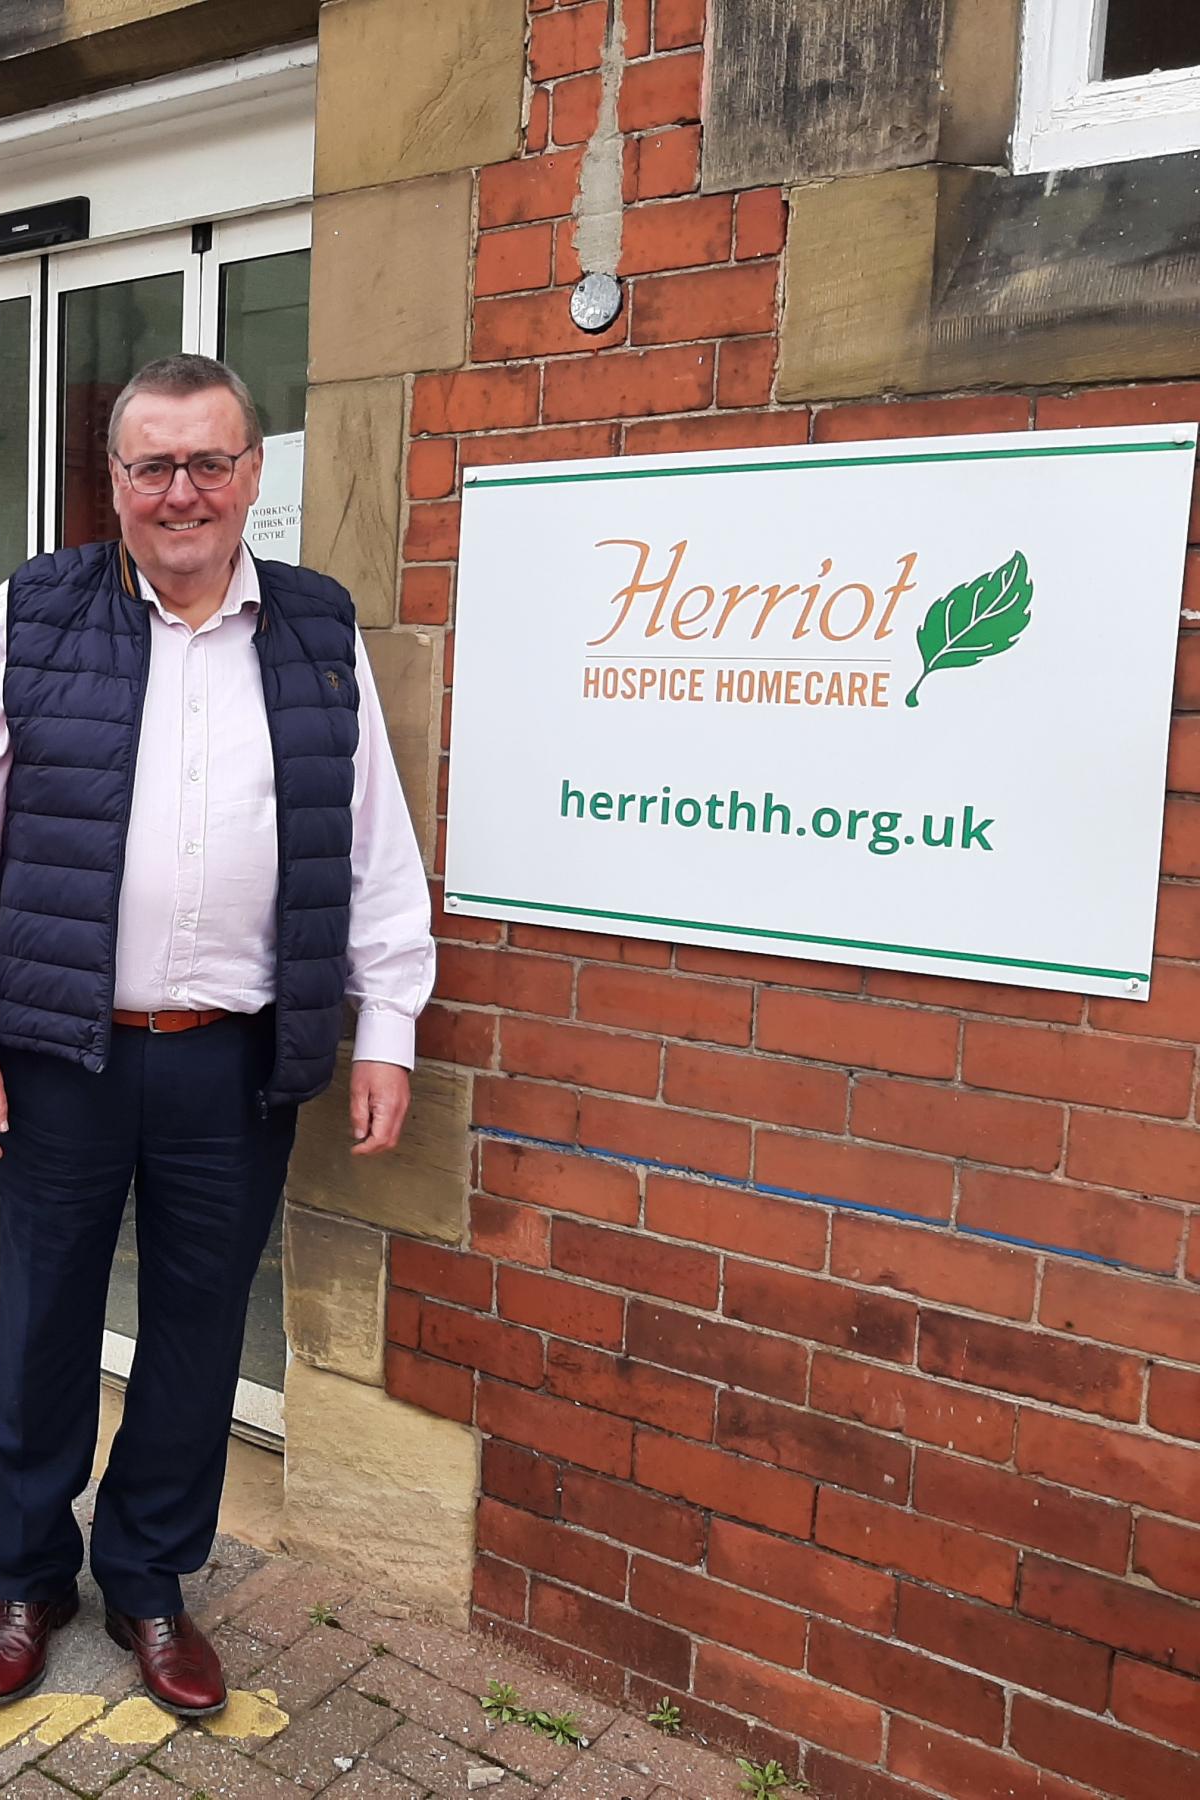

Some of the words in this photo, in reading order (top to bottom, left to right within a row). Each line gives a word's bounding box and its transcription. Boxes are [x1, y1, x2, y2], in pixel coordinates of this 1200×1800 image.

[251, 503, 295, 518] WORKING
[253, 517, 284, 531] THIRSK
[252, 529, 286, 542] CENTRE
[586, 538, 918, 646] Herriot
[583, 666, 705, 703] HOSPICE
[714, 668, 891, 708] HOMECARE
[559, 779, 996, 856] herriothh.org.uk
